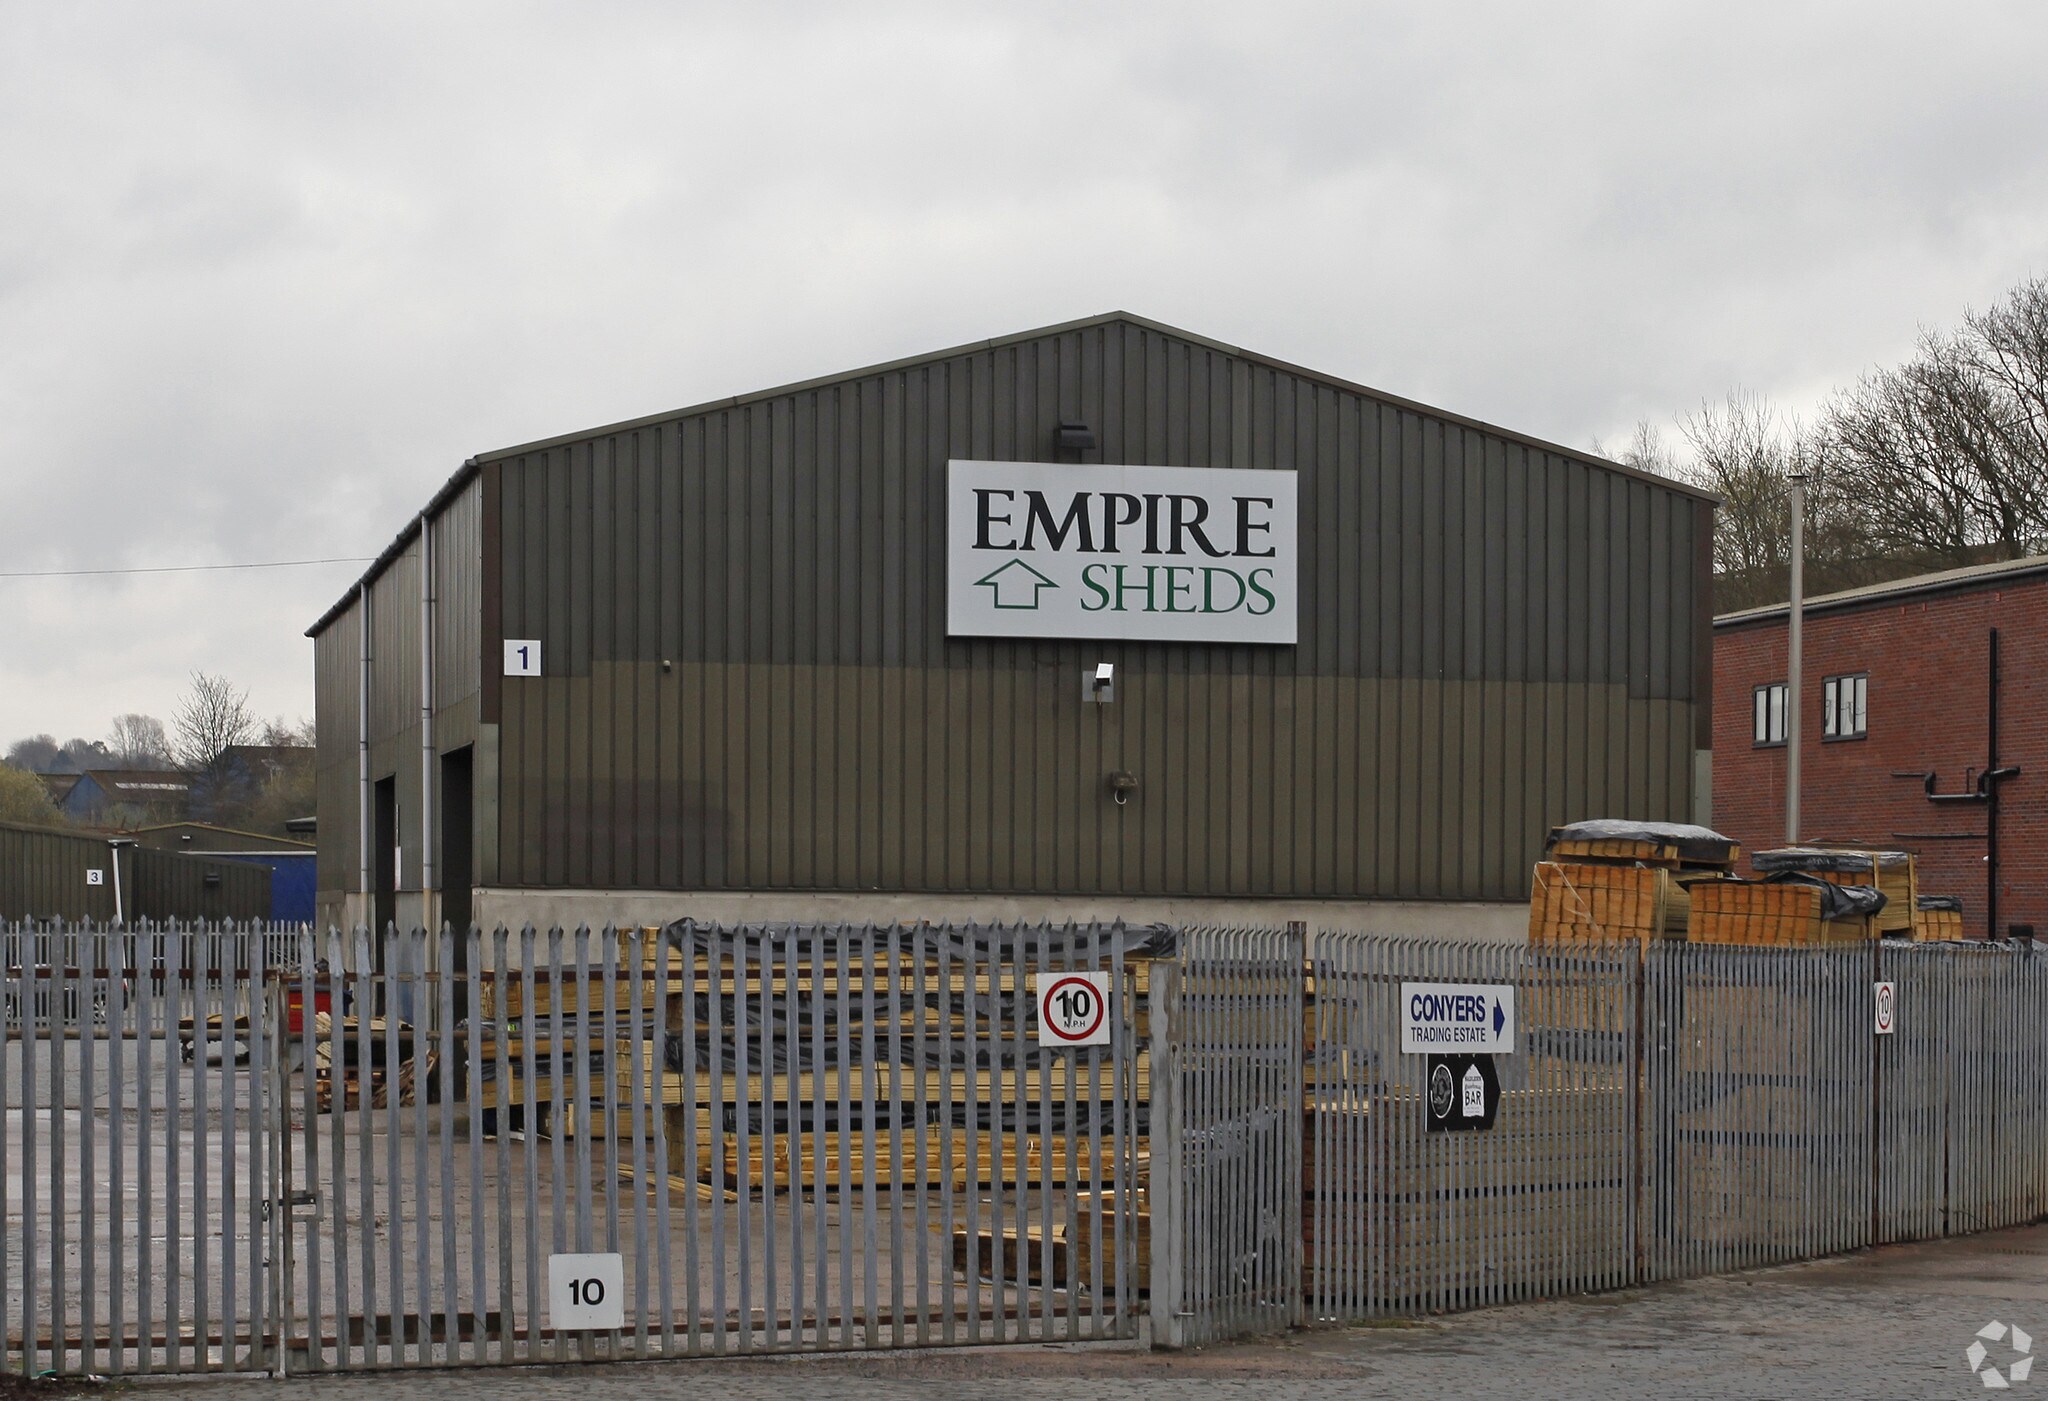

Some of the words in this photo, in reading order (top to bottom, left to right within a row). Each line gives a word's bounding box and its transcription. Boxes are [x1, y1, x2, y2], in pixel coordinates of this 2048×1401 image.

[971, 487, 1276, 558] EMPIRE
[1080, 563, 1276, 615] SHEDS
[517, 645, 528, 670] 1
[91, 871, 99, 883] 3
[1055, 989, 1091, 1018] 10
[1410, 993, 1486, 1023] CONYERS
[1881, 995, 1889, 1014] 10
[1410, 1026, 1452, 1042] TRADING
[1453, 1027, 1486, 1043] ESTATE
[1465, 1090, 1482, 1106] BAR
[568, 1278, 605, 1306] 10
